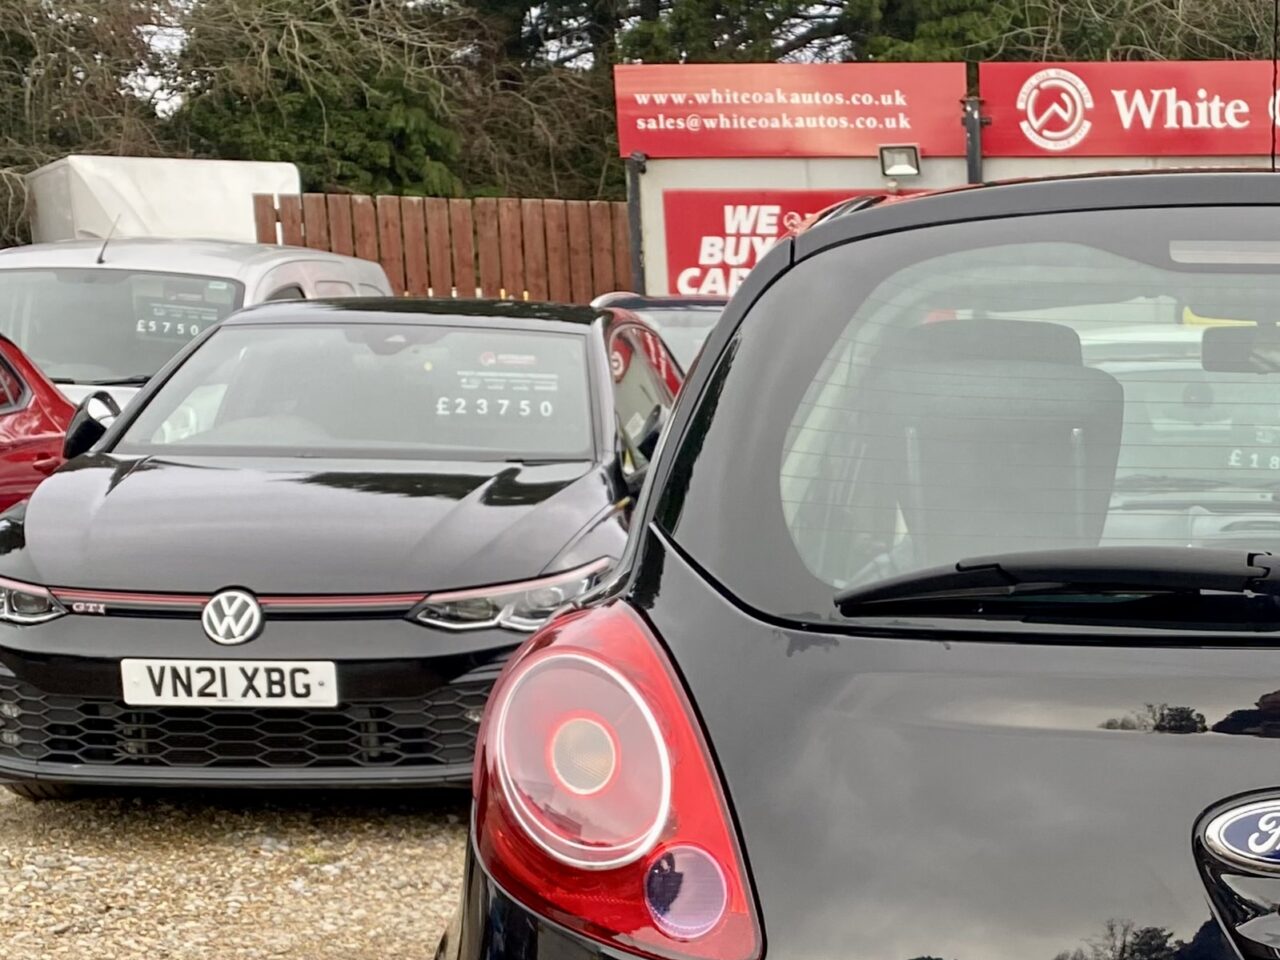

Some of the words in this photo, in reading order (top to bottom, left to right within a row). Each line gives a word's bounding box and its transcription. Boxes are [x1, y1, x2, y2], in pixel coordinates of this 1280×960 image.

[1110, 86, 1251, 131] White
[723, 204, 782, 235] WE
[698, 235, 778, 266] BUY
[135, 319, 200, 336] £5750
[436, 396, 553, 417] £23750
[72, 602, 106, 615] GTI
[146, 665, 229, 699] VN21
[239, 667, 312, 700] XBG
